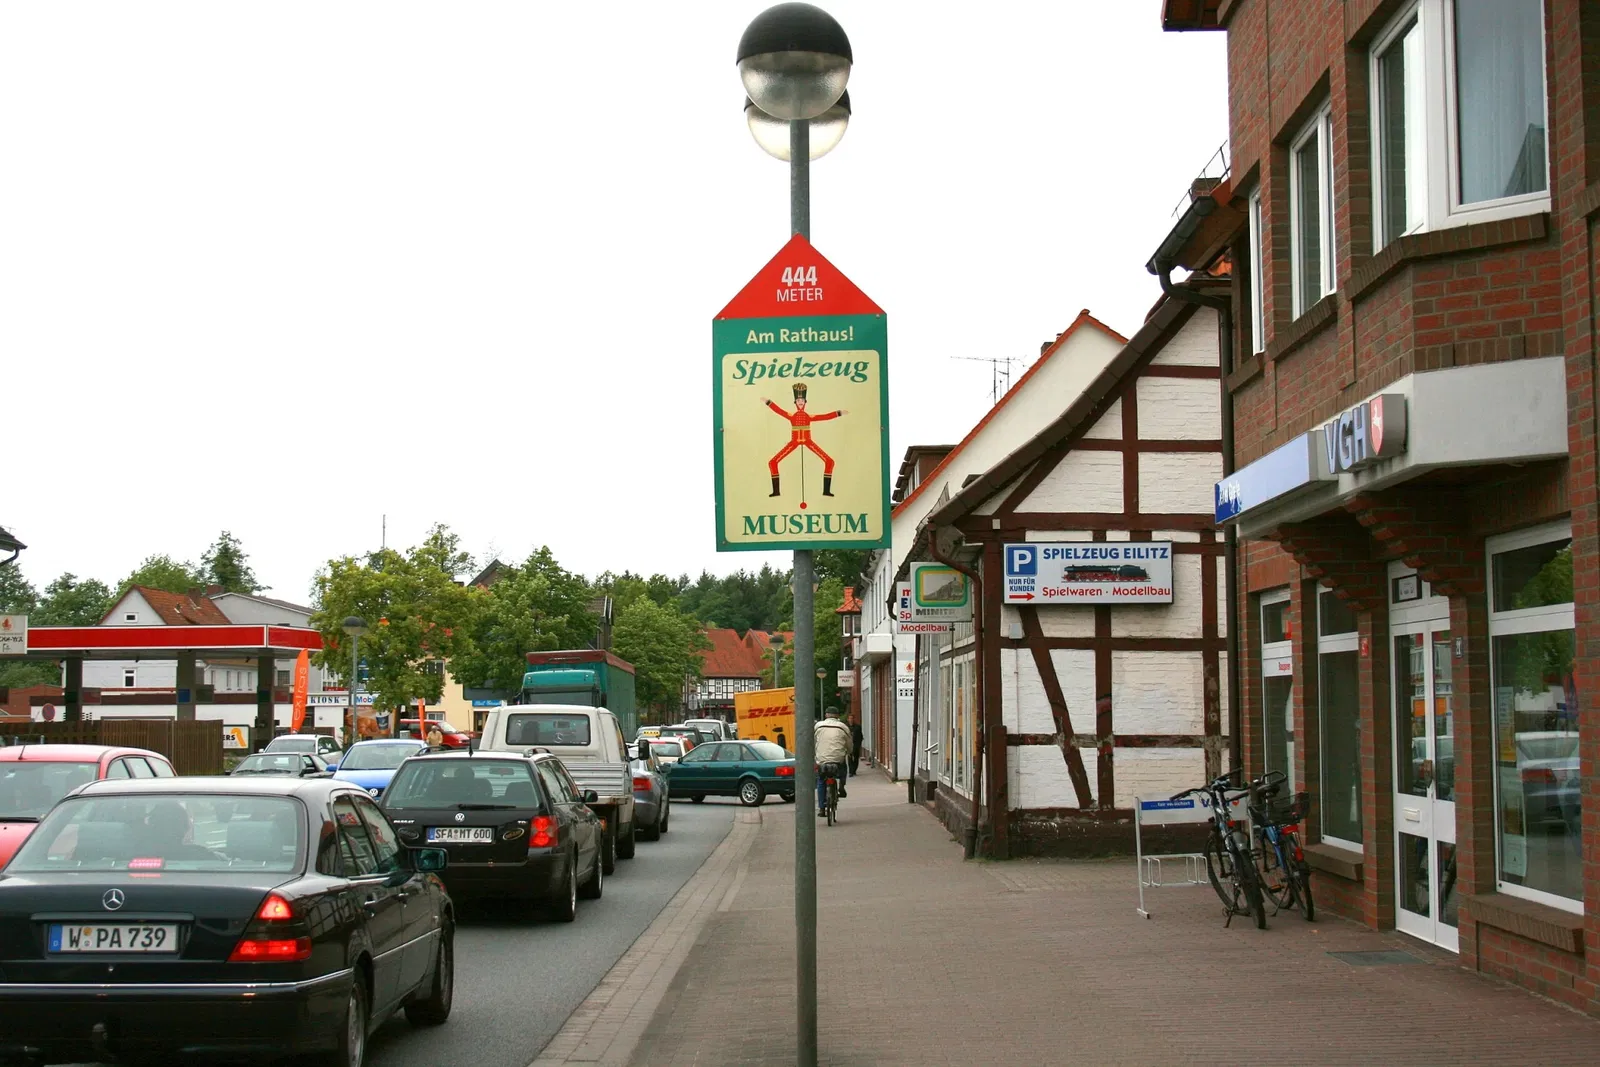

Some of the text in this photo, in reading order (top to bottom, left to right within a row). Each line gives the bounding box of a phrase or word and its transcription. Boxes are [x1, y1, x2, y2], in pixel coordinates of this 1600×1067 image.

[781, 265, 818, 287] 444
[776, 287, 823, 302] METER
[746, 326, 854, 344] Am Rathaus!
[732, 356, 869, 385] Spielzeug
[1324, 402, 1369, 474] VGH
[742, 513, 869, 536] MUSEUM
[1013, 549, 1032, 573] P
[1043, 547, 1168, 560] SPIELZEUG EILITZ
[1023, 576, 1035, 585] FÜR
[1042, 586, 1171, 597] Spielwaren Modellbau
[900, 623, 948, 632] Modellbau
[310, 696, 340, 704] KIOSK
[747, 705, 793, 719] DHL
[435, 829, 453, 839] SFA
[459, 829, 472, 839] MT
[473, 828, 491, 839] 600
[68, 928, 167, 948] W PA 739
